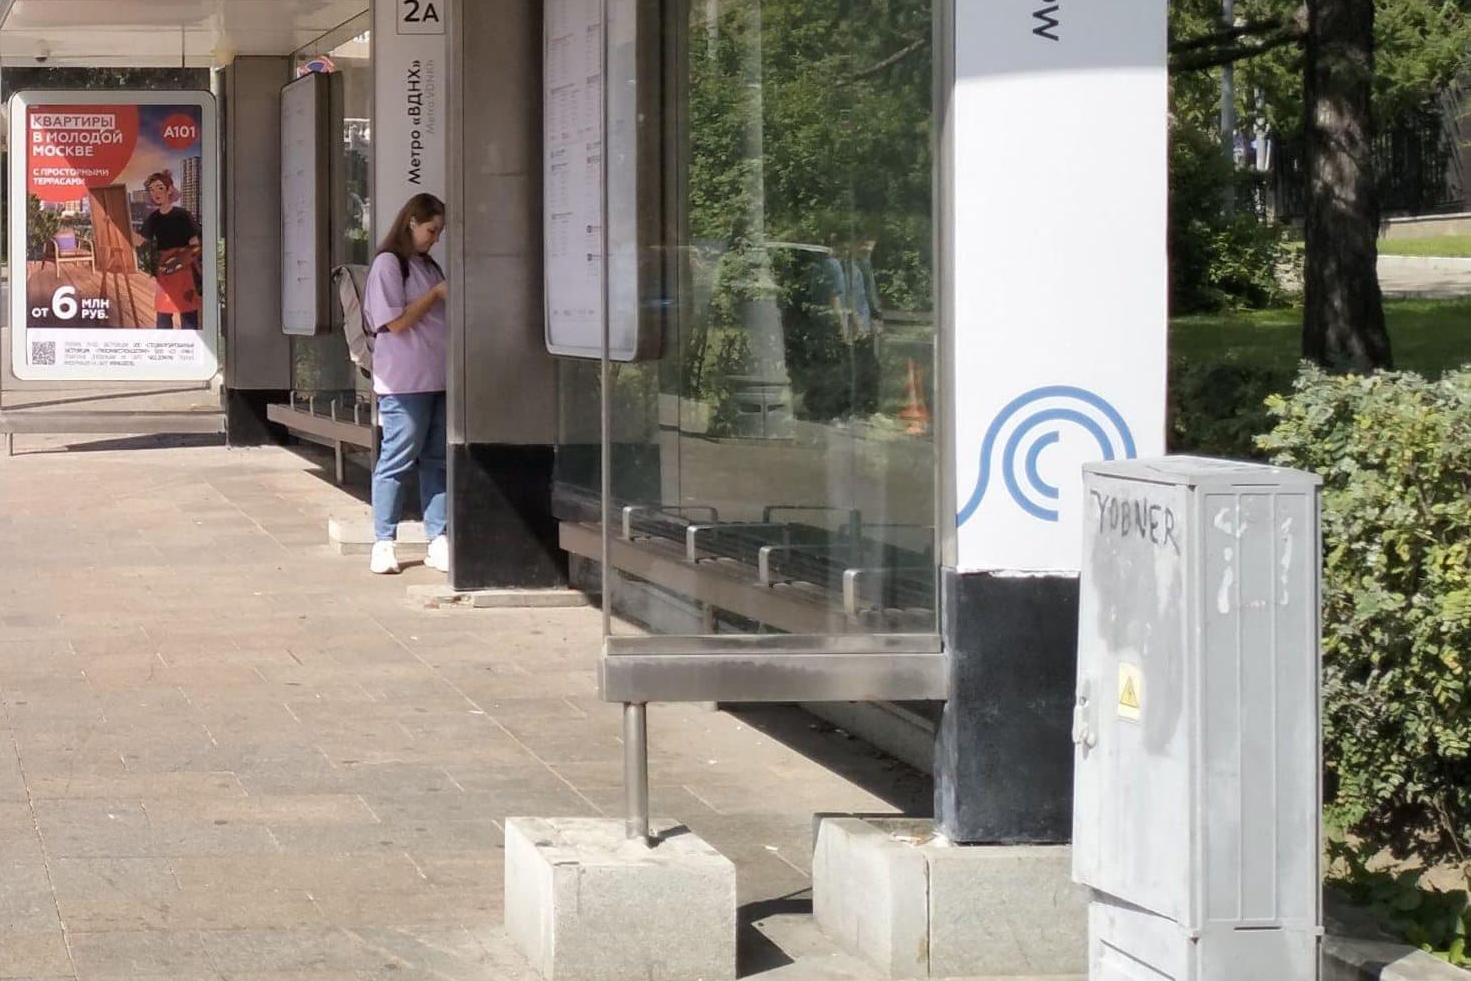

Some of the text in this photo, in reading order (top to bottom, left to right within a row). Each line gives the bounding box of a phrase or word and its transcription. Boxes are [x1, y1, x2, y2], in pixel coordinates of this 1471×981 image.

[403, 0, 440, 23] 2А
[33, 115, 114, 127] КВАРТИРЫ
[407, 60, 424, 185] Метро «ВДНХ»
[32, 129, 123, 145] В МОЛОДОЙ
[163, 125, 196, 138] А101
[32, 145, 94, 157] МОСКВЕ
[33, 168, 110, 176] С ПРОСТОРНЫМИ
[33, 177, 86, 186] ТЕРРАСАМИ
[51, 285, 78, 320] 6
[81, 298, 110, 309] МЛН
[81, 309, 109, 320] РУБ.
